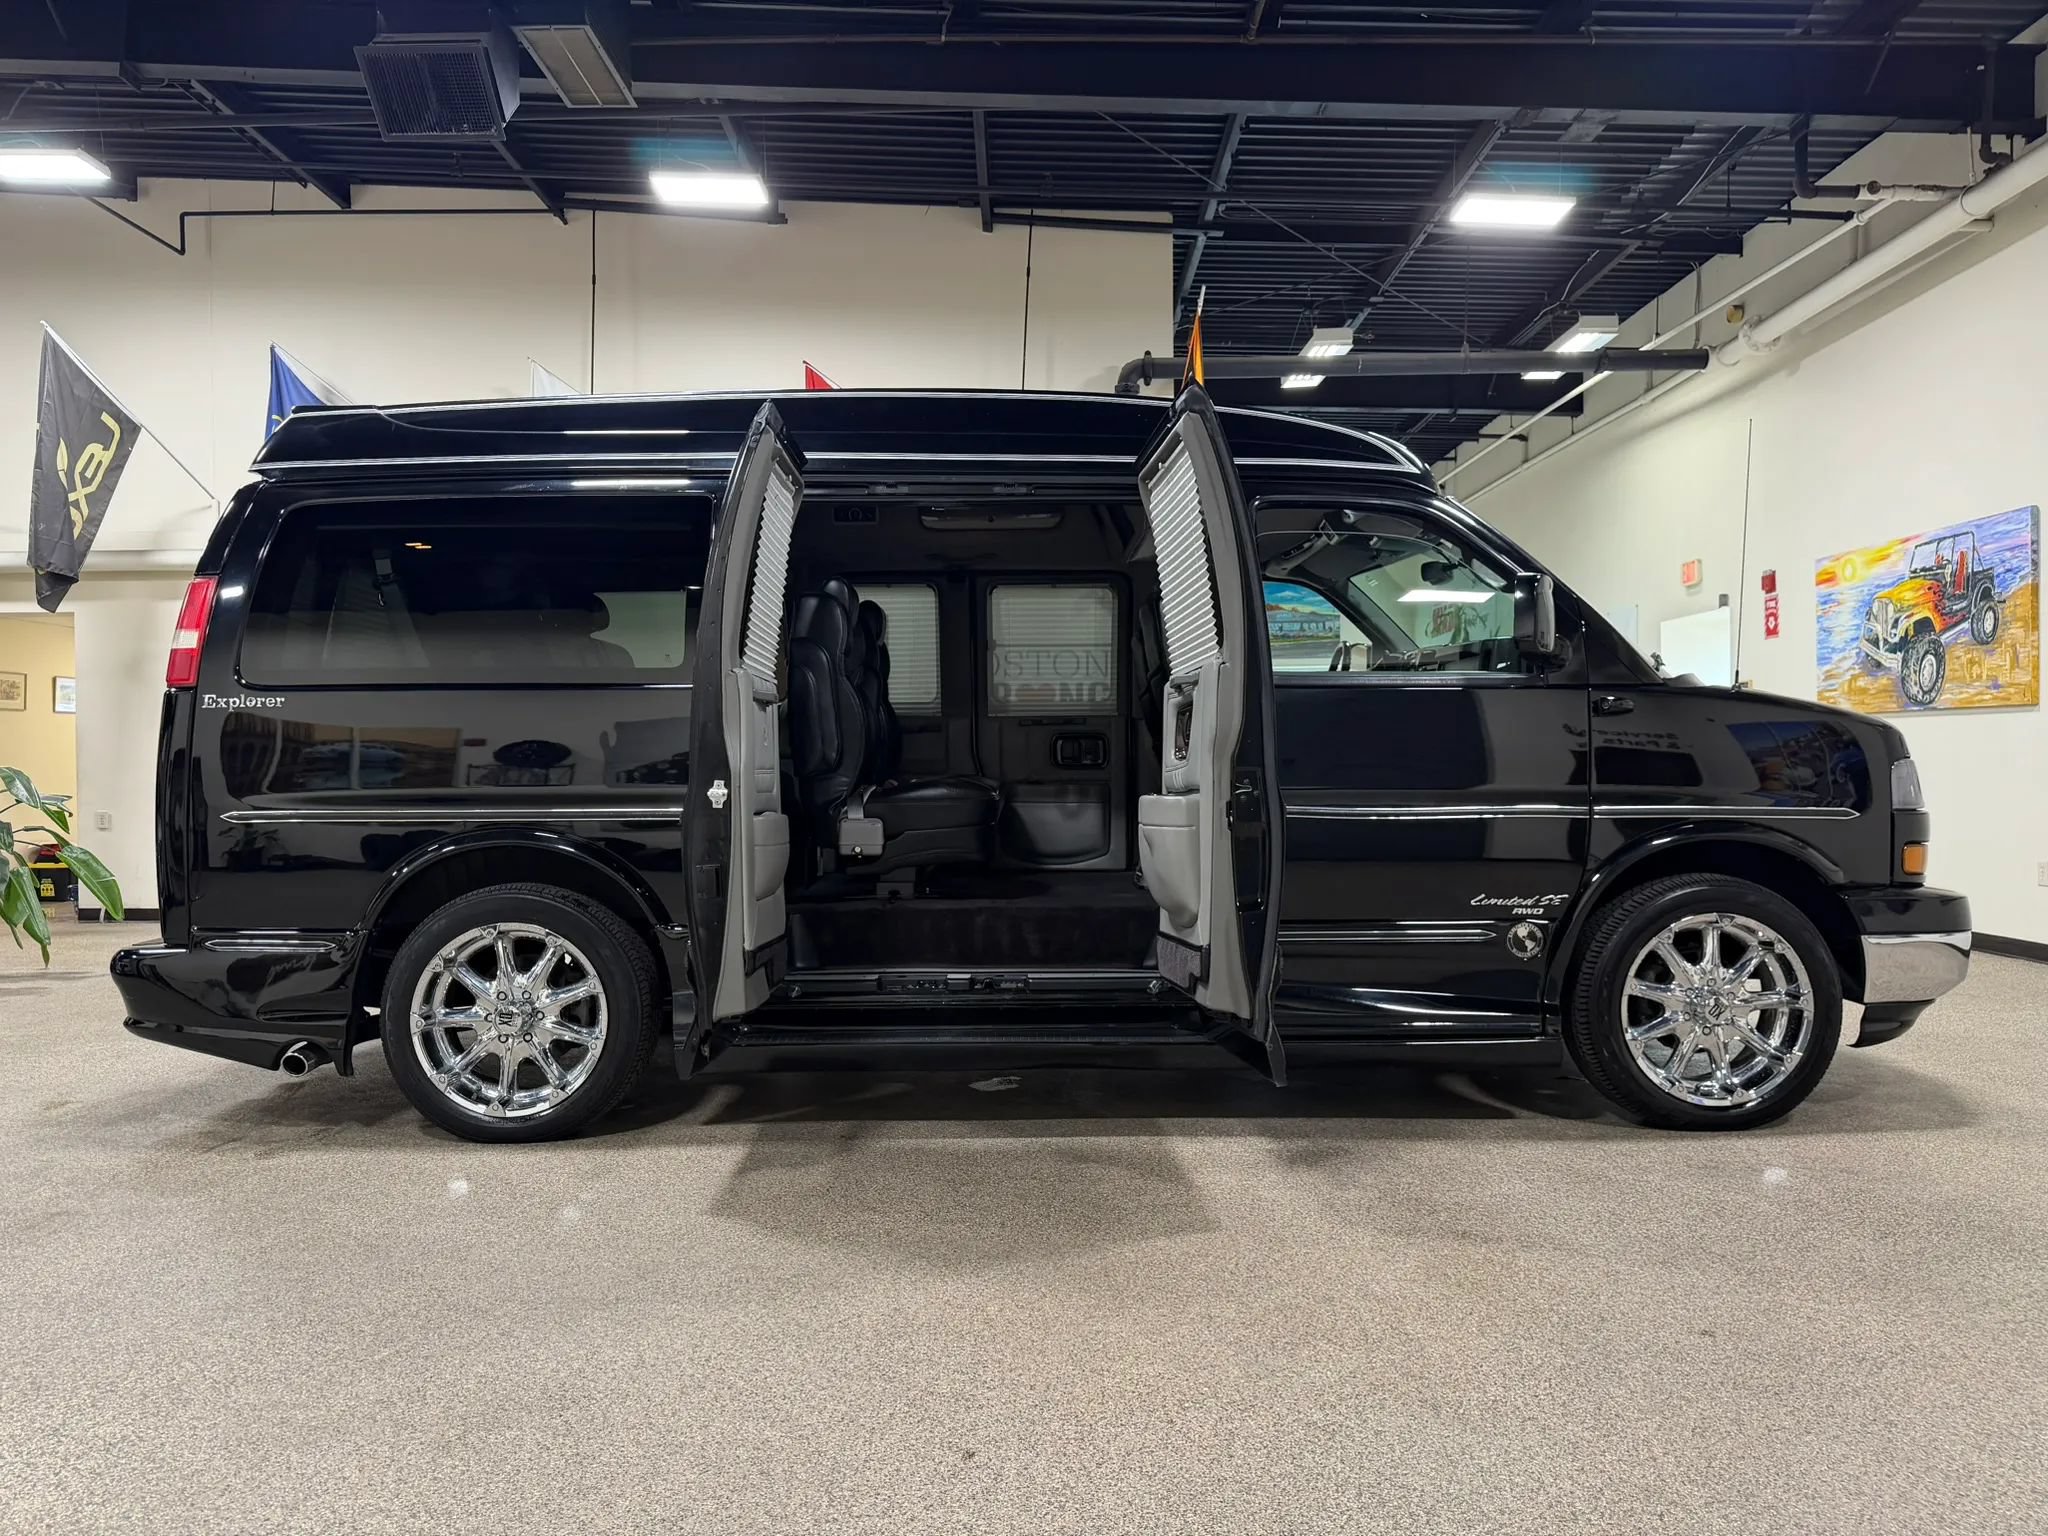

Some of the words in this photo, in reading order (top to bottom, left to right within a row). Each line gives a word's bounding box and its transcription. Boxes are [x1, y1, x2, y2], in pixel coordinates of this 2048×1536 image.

[201, 693, 286, 712] Explorer
[1470, 893, 1540, 906] Limited
[1511, 907, 1545, 916] AWD
